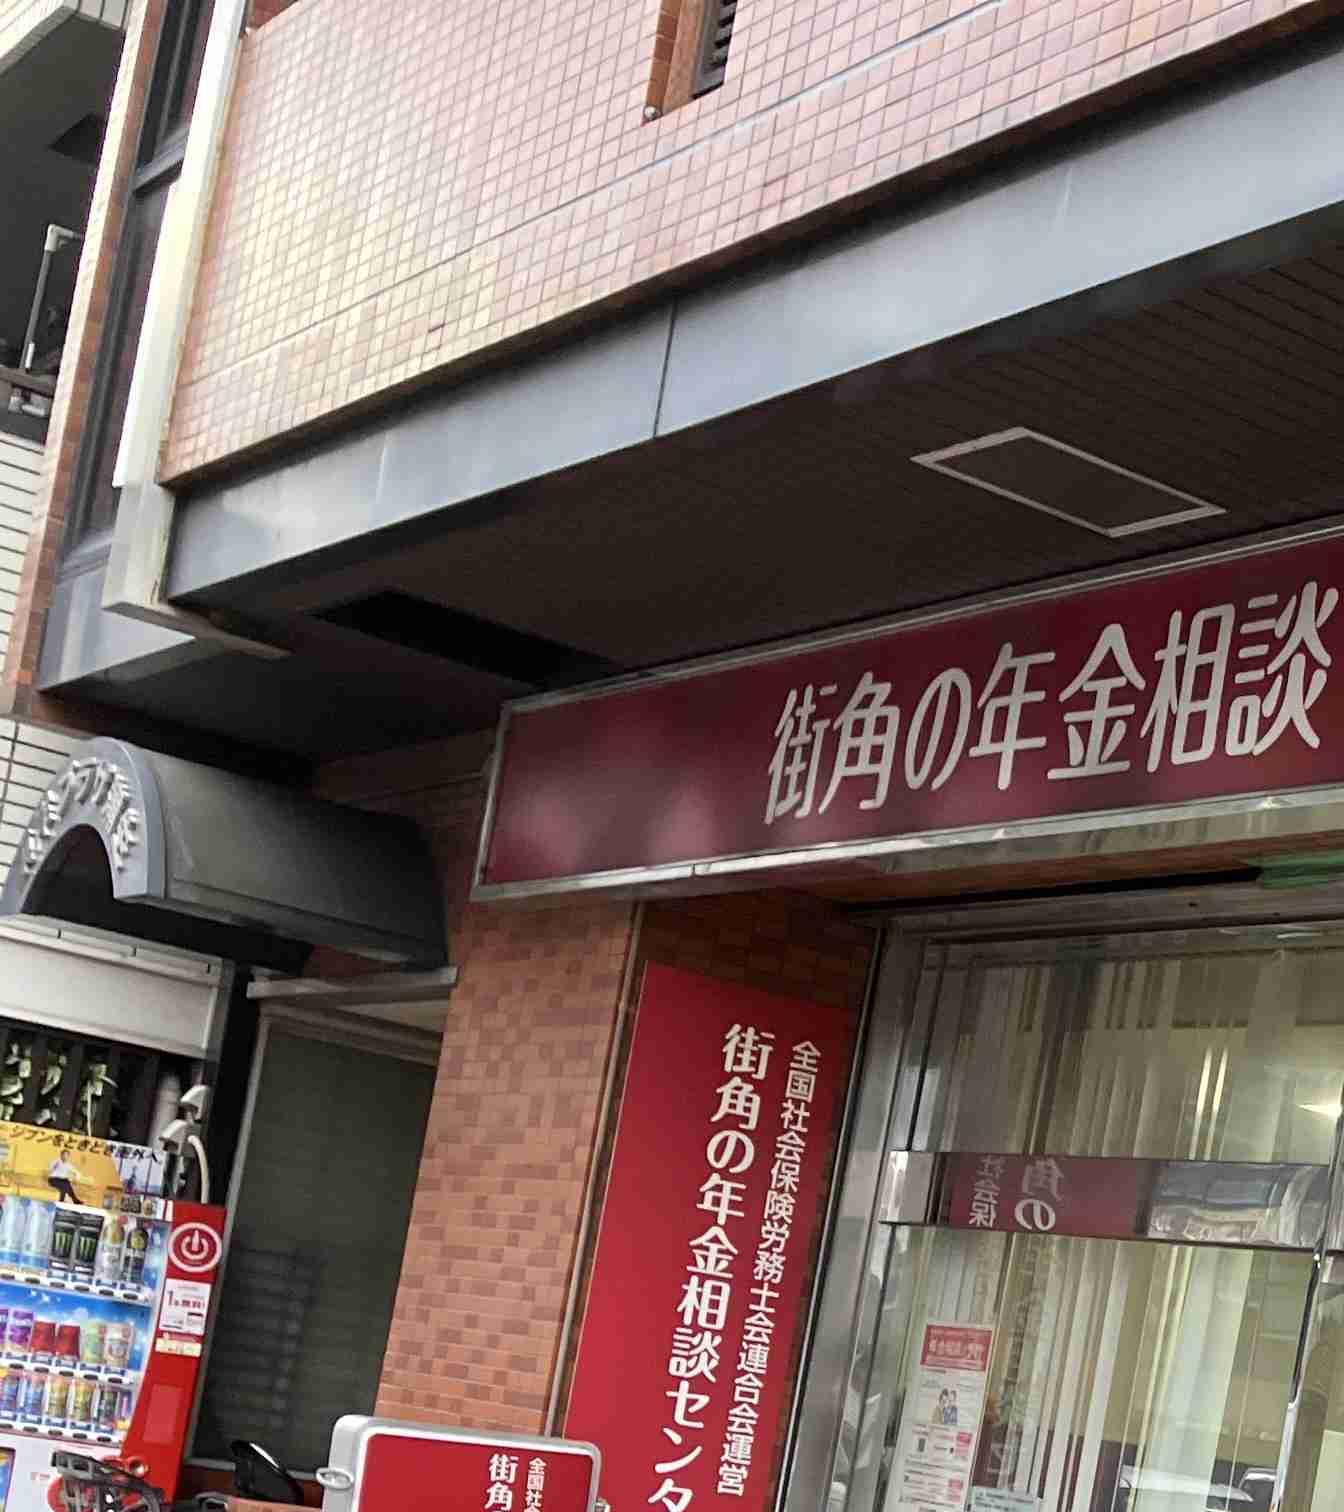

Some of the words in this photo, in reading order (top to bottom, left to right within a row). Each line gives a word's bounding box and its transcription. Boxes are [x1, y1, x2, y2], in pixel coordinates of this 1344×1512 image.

[716, 1040, 822, 1497] 全国社会保険労務士会連合会運営
